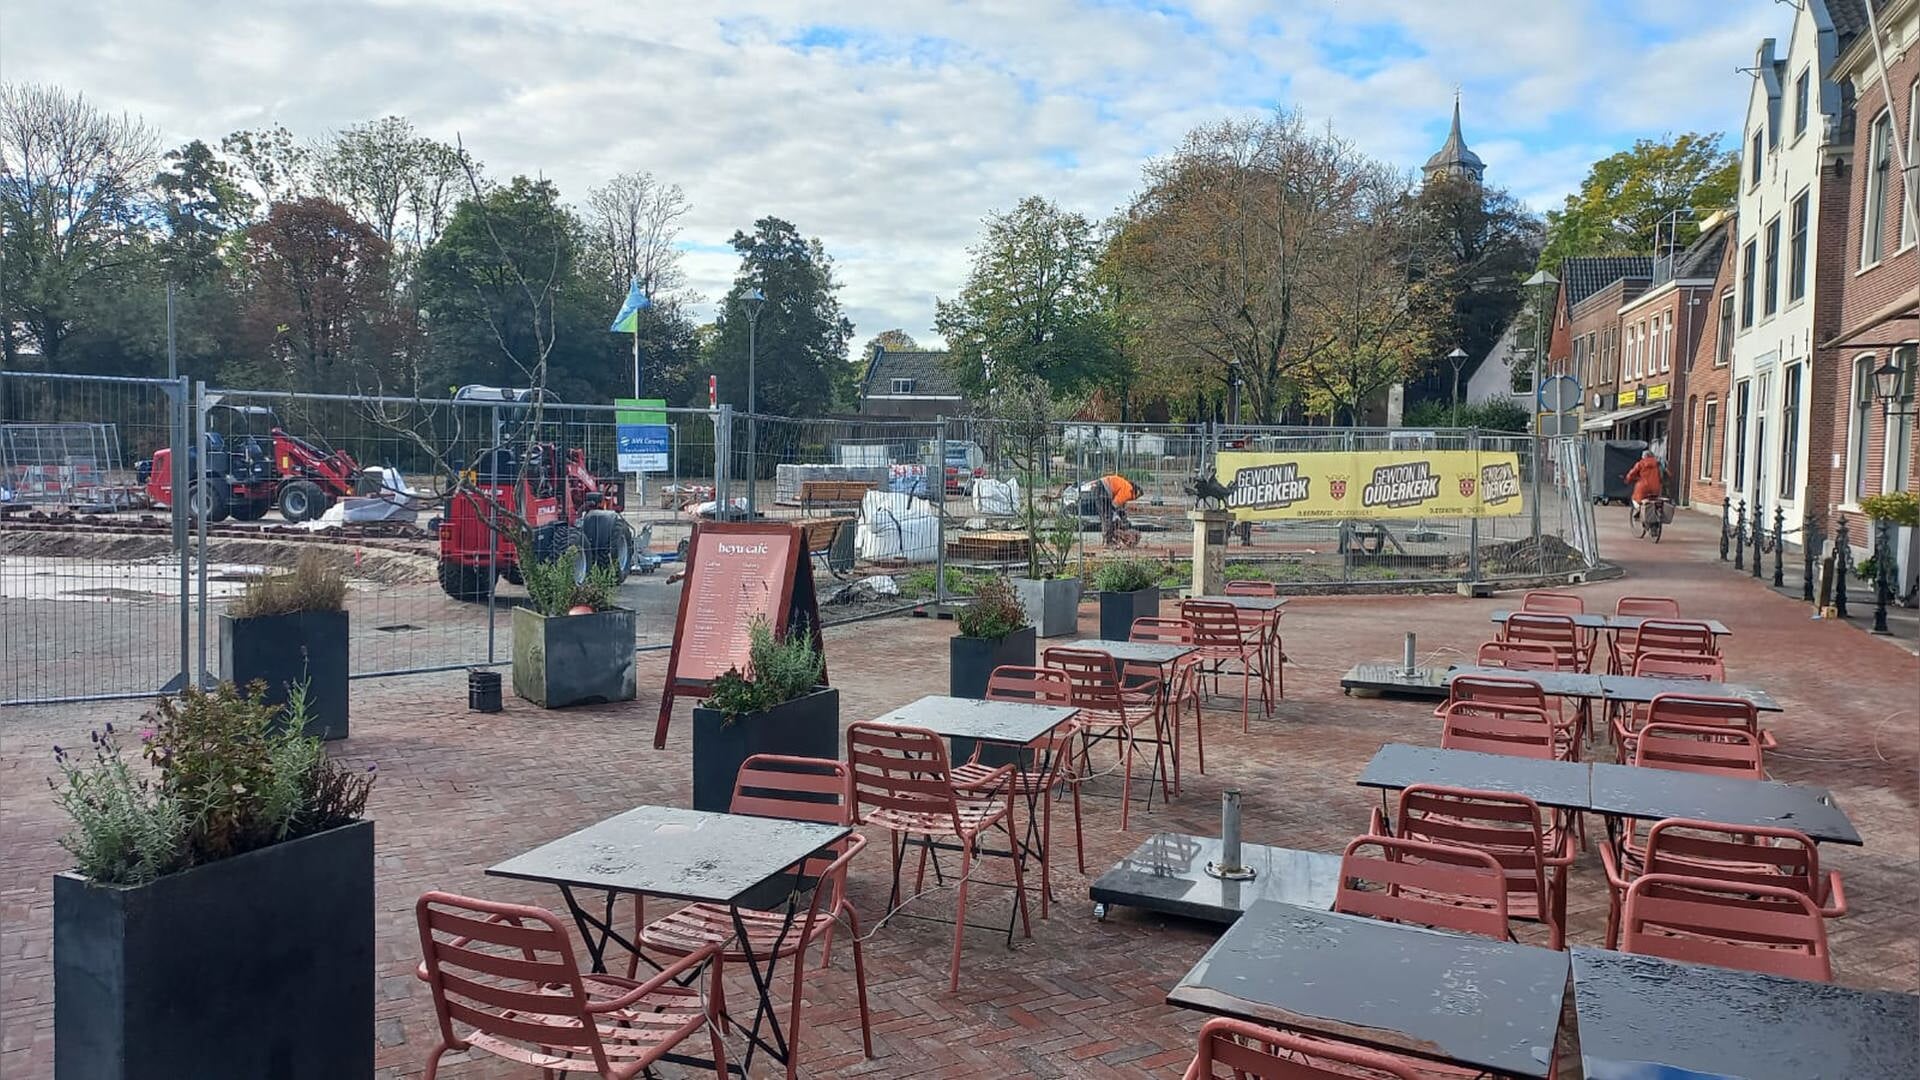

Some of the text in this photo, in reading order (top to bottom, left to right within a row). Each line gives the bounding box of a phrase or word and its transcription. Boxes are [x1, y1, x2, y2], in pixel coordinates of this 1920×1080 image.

[1237, 466, 1296, 487] GEWOON IN
[1374, 464, 1428, 485] GEWOON IN
[1364, 478, 1437, 505] OUDERKERK
[745, 541, 768, 554] café
